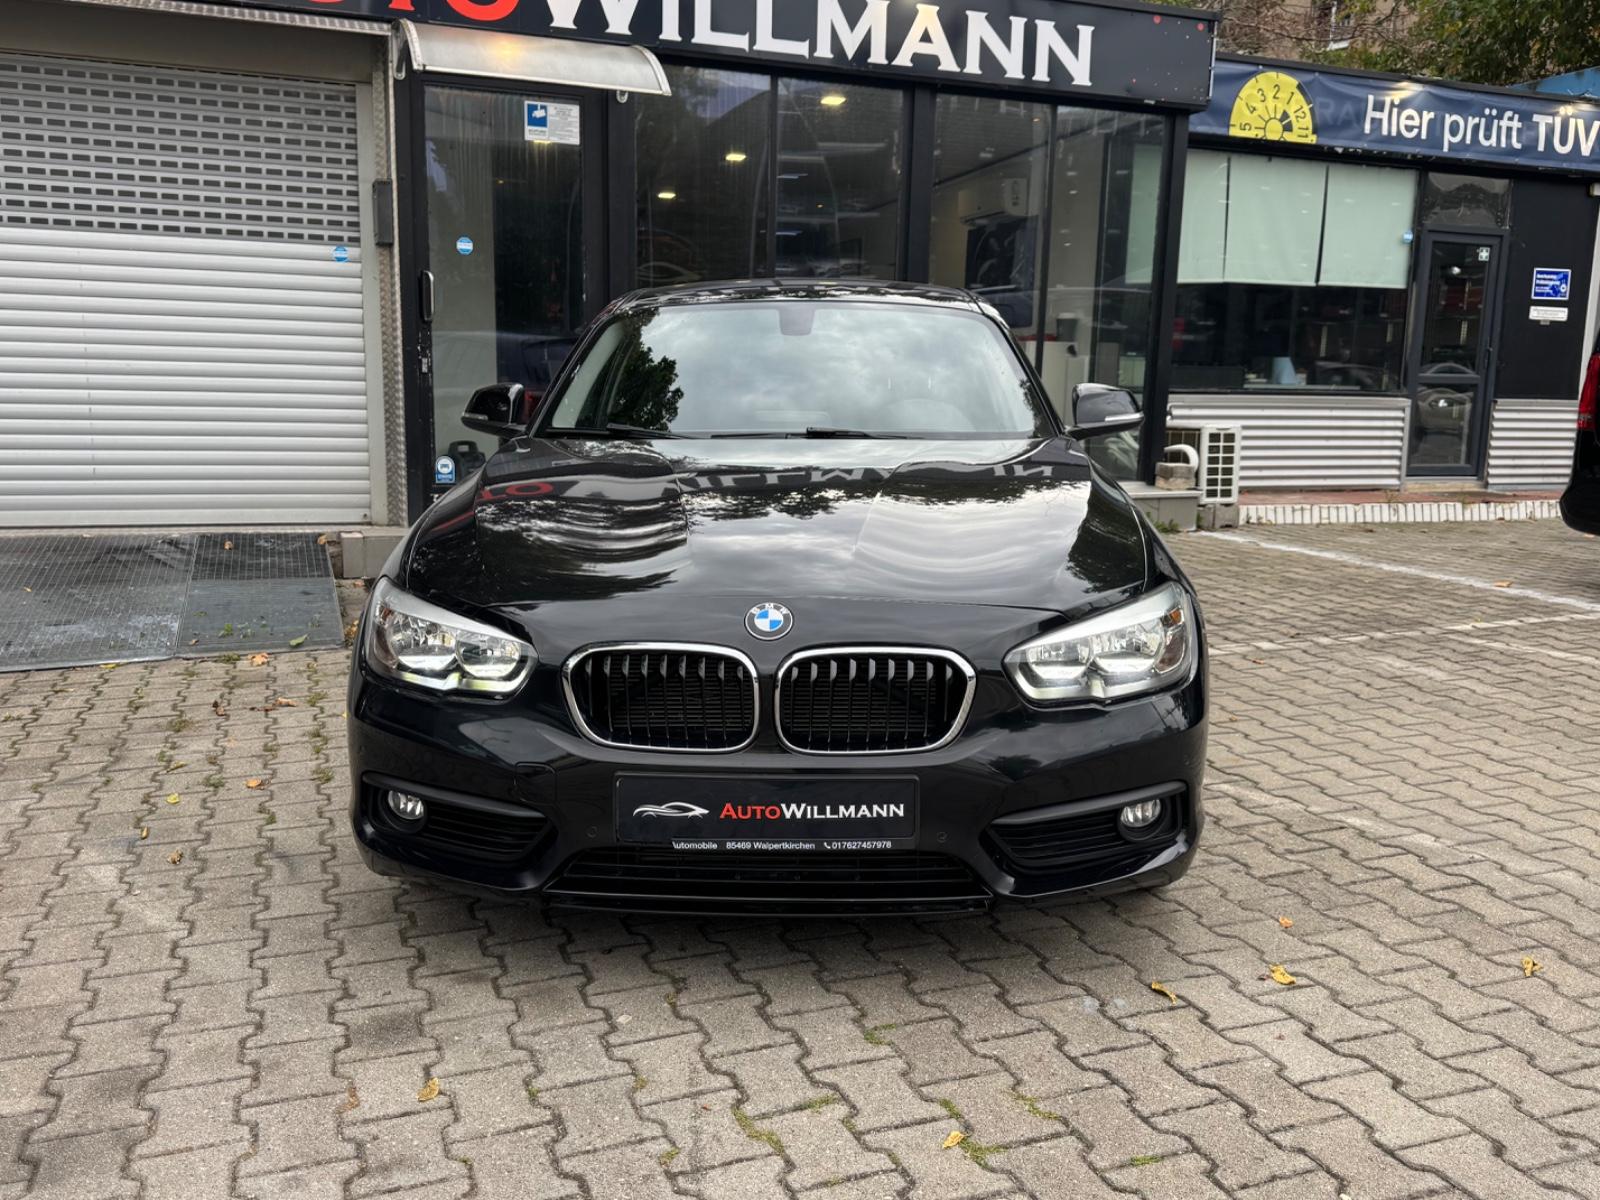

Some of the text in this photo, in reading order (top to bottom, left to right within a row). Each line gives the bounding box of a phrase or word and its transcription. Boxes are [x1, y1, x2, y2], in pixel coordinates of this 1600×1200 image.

[1364, 95, 1434, 139] Hier
[1443, 108, 1522, 152] prüft
[1533, 106, 1600, 156] TÜV
[751, 603, 790, 615] BMW
[726, 841, 752, 850] 85469
[832, 840, 892, 850] 017627457978
